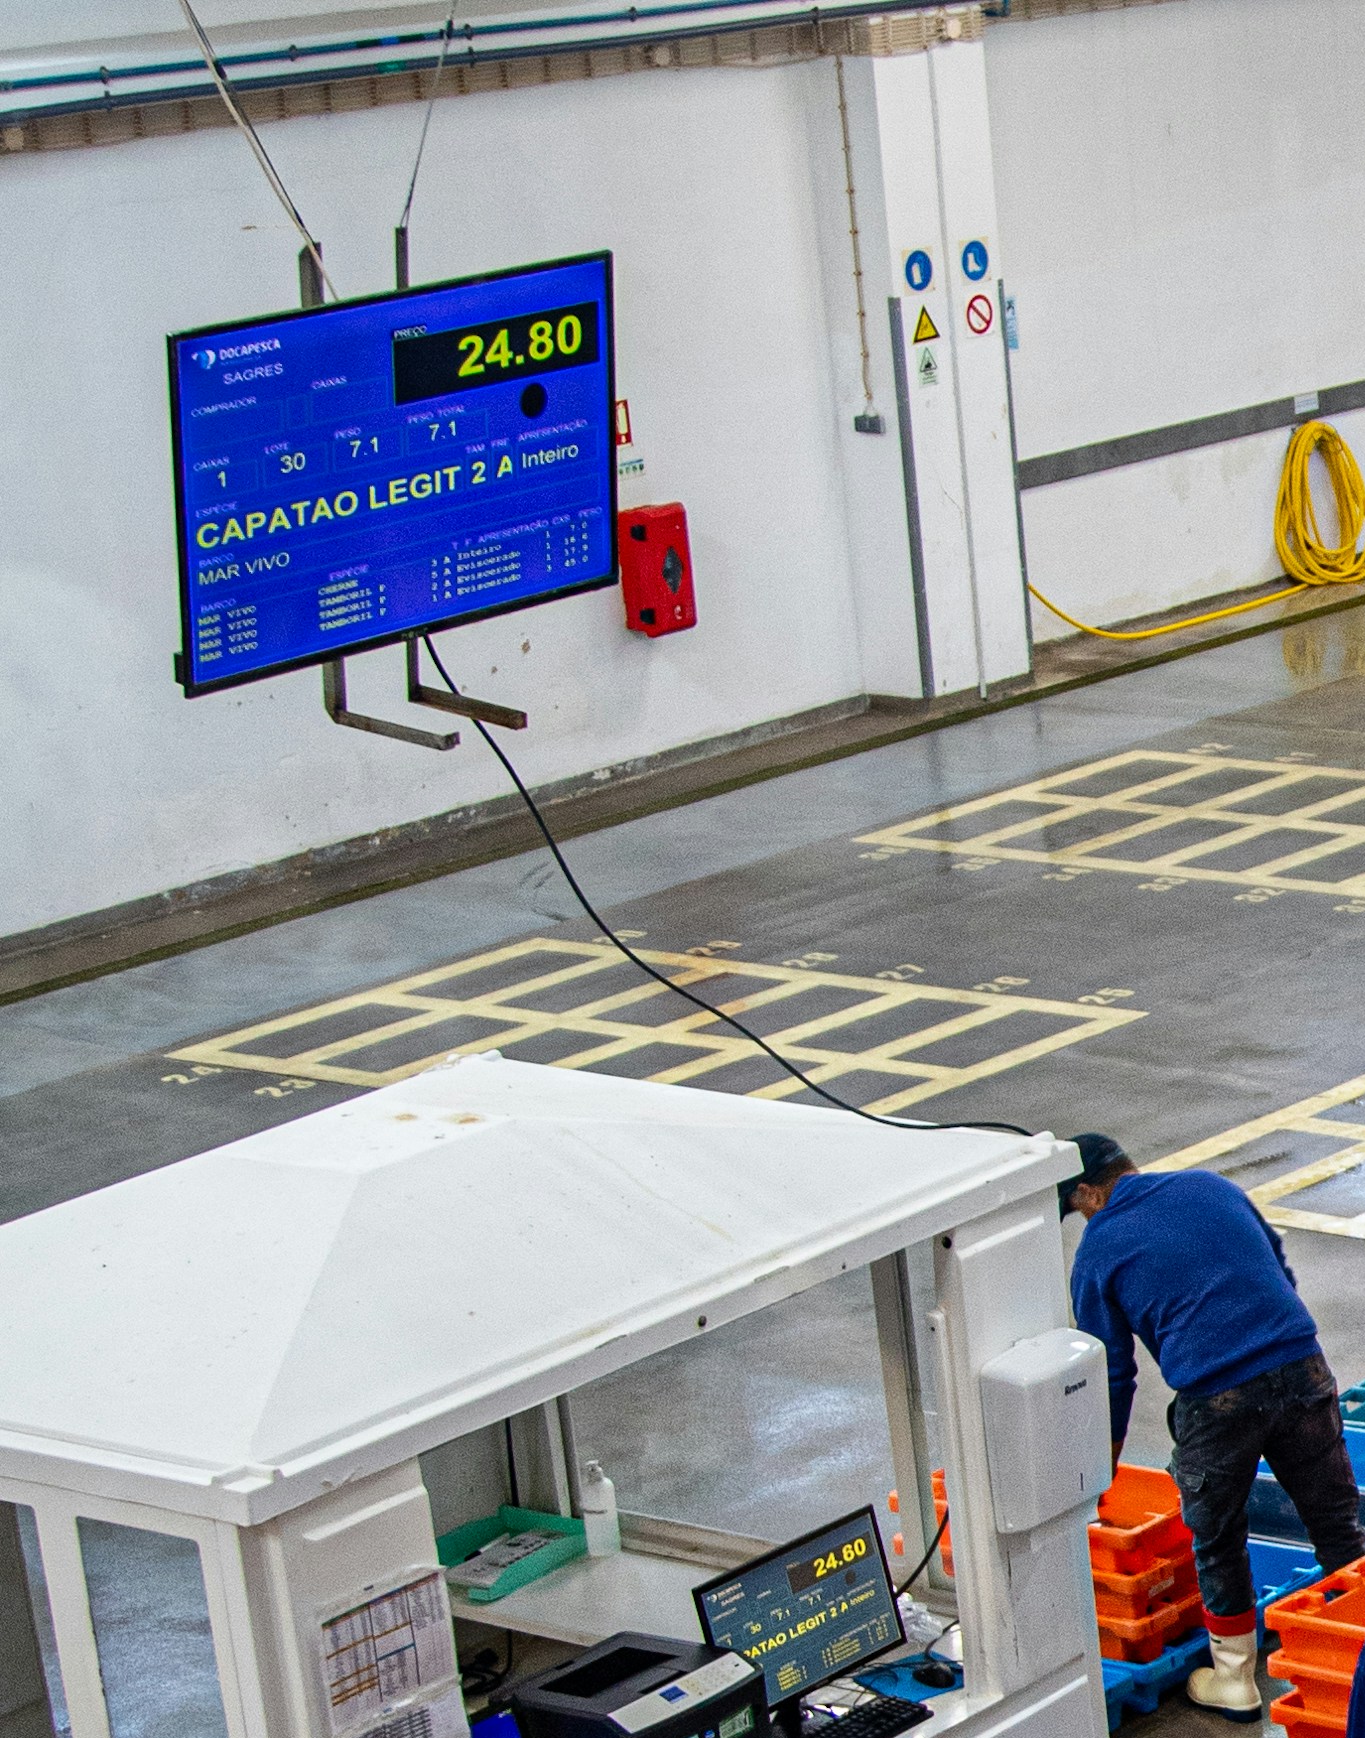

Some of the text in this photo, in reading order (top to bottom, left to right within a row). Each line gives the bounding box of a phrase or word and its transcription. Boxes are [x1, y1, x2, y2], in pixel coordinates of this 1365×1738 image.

[219, 338, 281, 361] DOCAPESCA
[458, 315, 582, 377] 24.80
[223, 363, 283, 385] SAGRES
[191, 396, 257, 418] COMPRADOR
[429, 421, 457, 441] 7.1
[350, 437, 379, 458] 7.1
[522, 444, 579, 468] Inteiro
[280, 452, 306, 474] 30
[217, 471, 226, 488] 1
[196, 455, 513, 548] CAPATAO LEGIT 2 A
[199, 552, 290, 585] MAR VIVO
[227, 605, 256, 618] VIVO
[457, 544, 501, 561] Inteiro
[228, 618, 257, 631] VIVO
[456, 550, 521, 573] Eviscerado
[228, 630, 257, 642] VIVO
[456, 562, 521, 584] Eviscerado
[229, 641, 258, 654] VIVO
[456, 574, 521, 596] Eviscerado
[876, 963, 926, 980] 27
[1078, 987, 1135, 1005] 25
[161, 1065, 225, 1085] 24
[254, 1079, 318, 1097] 23
[813, 1538, 867, 1578] 24.60
[808, 1594, 822, 1606] 7.1
[777, 1609, 791, 1621] 7.1
[789, 1611, 827, 1640] LEGIT
[830, 1606, 838, 1617] 2
[840, 1601, 849, 1613] A
[750, 1623, 762, 1635] 30
